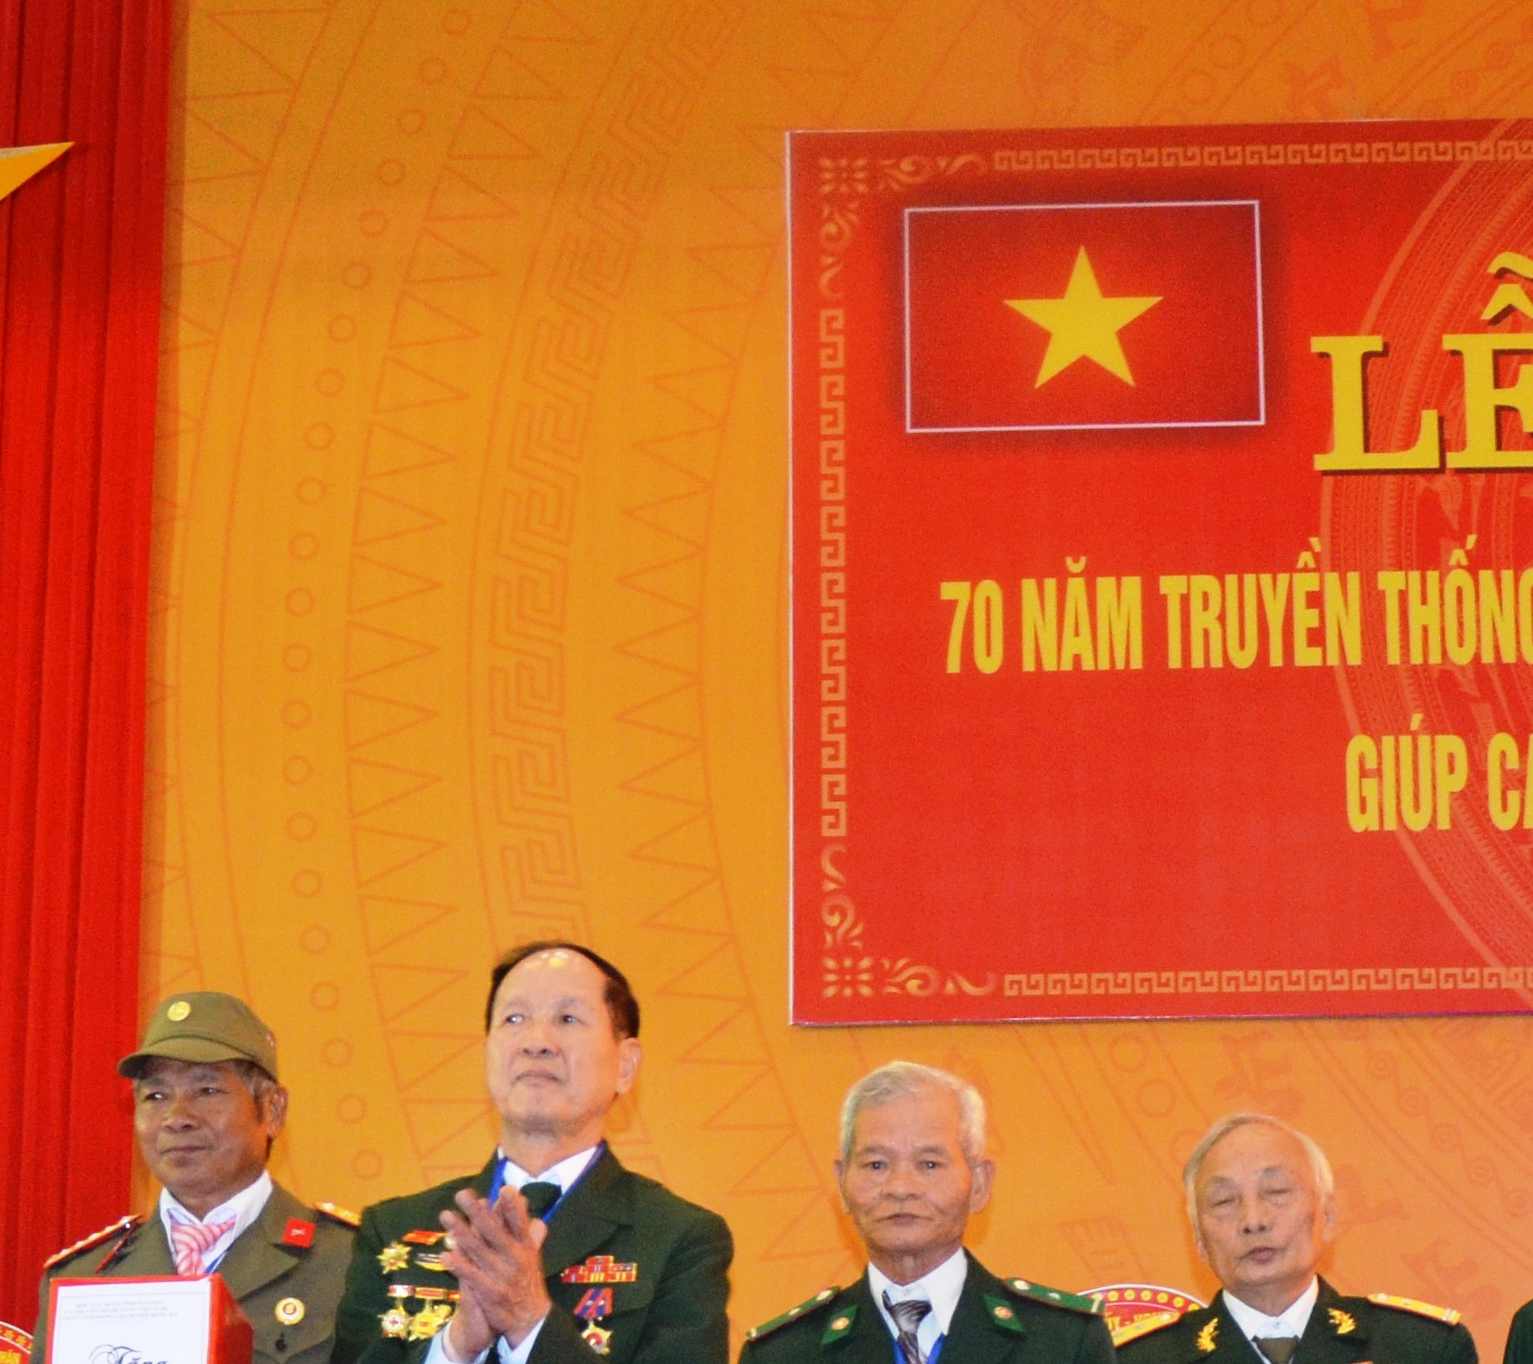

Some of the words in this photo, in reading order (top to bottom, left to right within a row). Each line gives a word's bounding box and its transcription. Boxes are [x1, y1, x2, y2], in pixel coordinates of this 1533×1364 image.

[939, 579, 1004, 674] 70
[1021, 557, 1143, 673] NĂM
[1159, 537, 1363, 669] TRUYỀN
[1344, 715, 1469, 834] GIÚP
